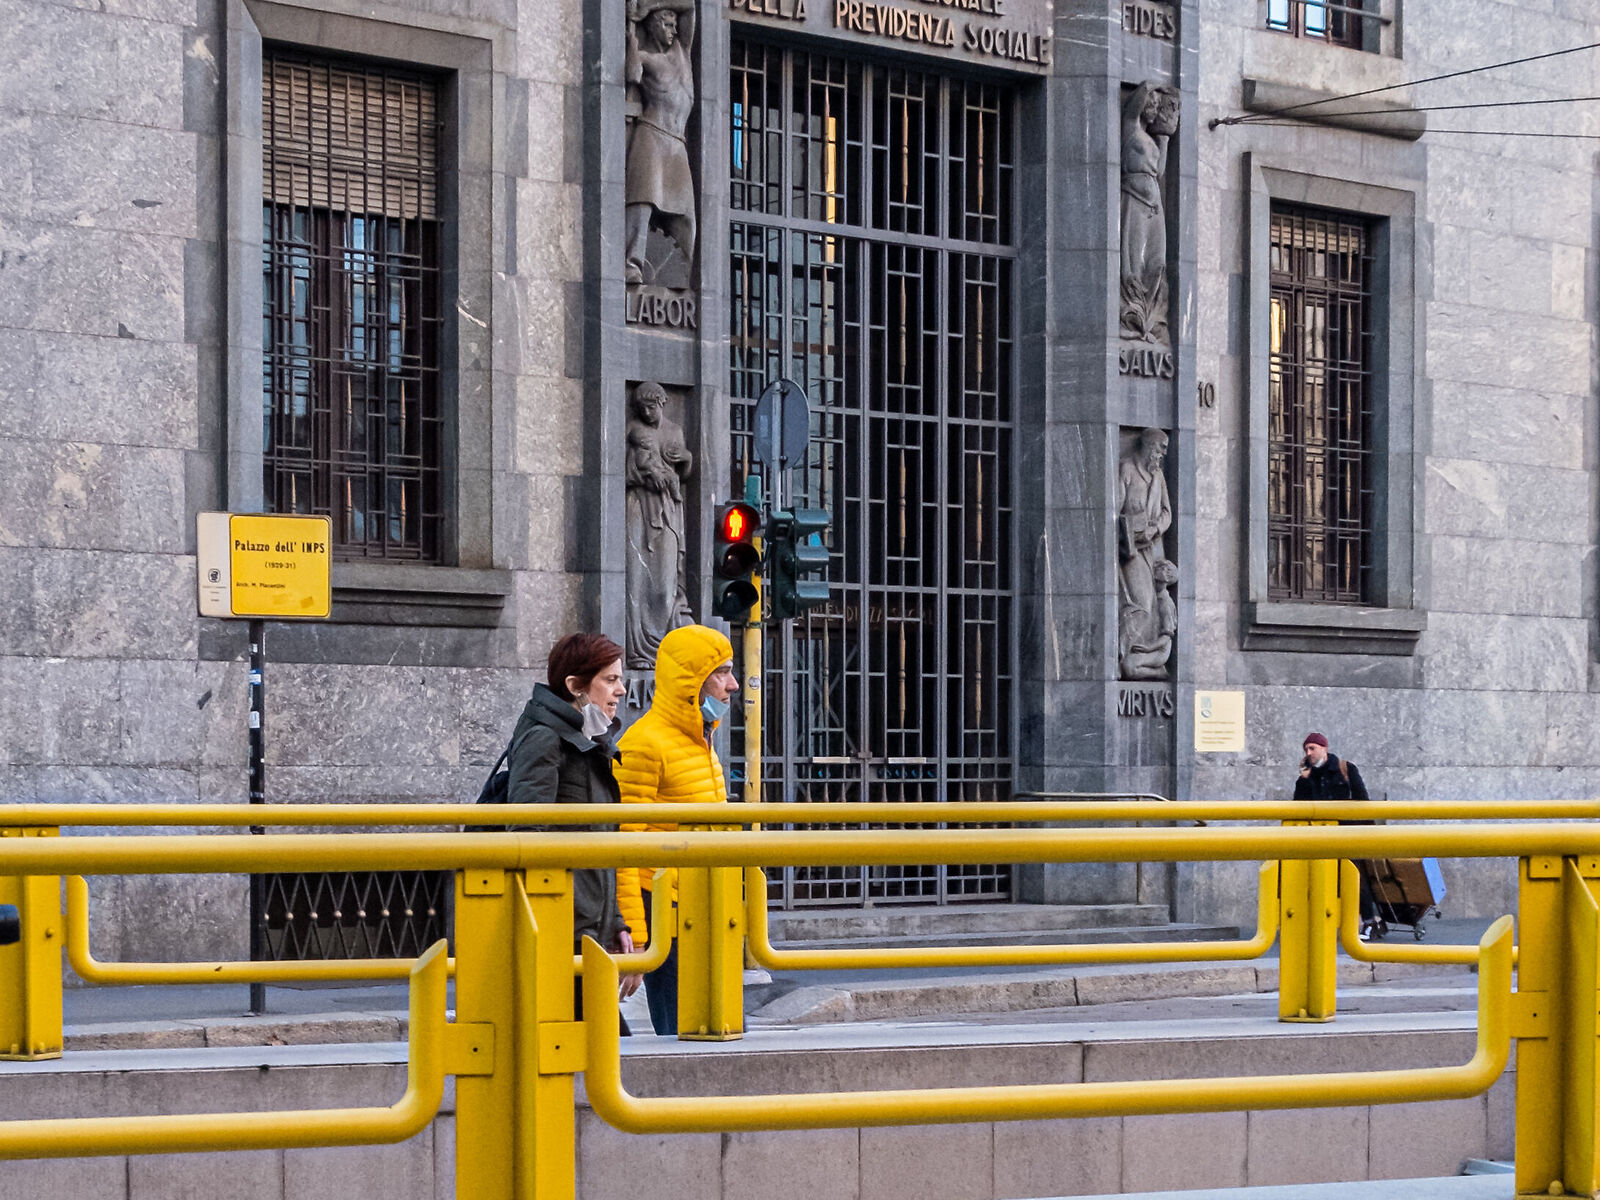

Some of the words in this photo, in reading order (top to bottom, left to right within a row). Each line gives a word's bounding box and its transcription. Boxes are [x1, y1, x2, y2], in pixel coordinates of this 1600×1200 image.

[832, 0, 956, 48] PREVIDENZA
[962, 23, 1050, 67] SOCIALE
[1121, 2, 1176, 39] FIDES
[625, 291, 698, 330] LABOR
[1119, 348, 1175, 379] SALVS
[1197, 381, 1214, 408] 10
[234, 540, 270, 552] Palazzo
[275, 542, 297, 553] dell'
[301, 542, 325, 554] INPS
[1117, 688, 1174, 718] VIRTVS
